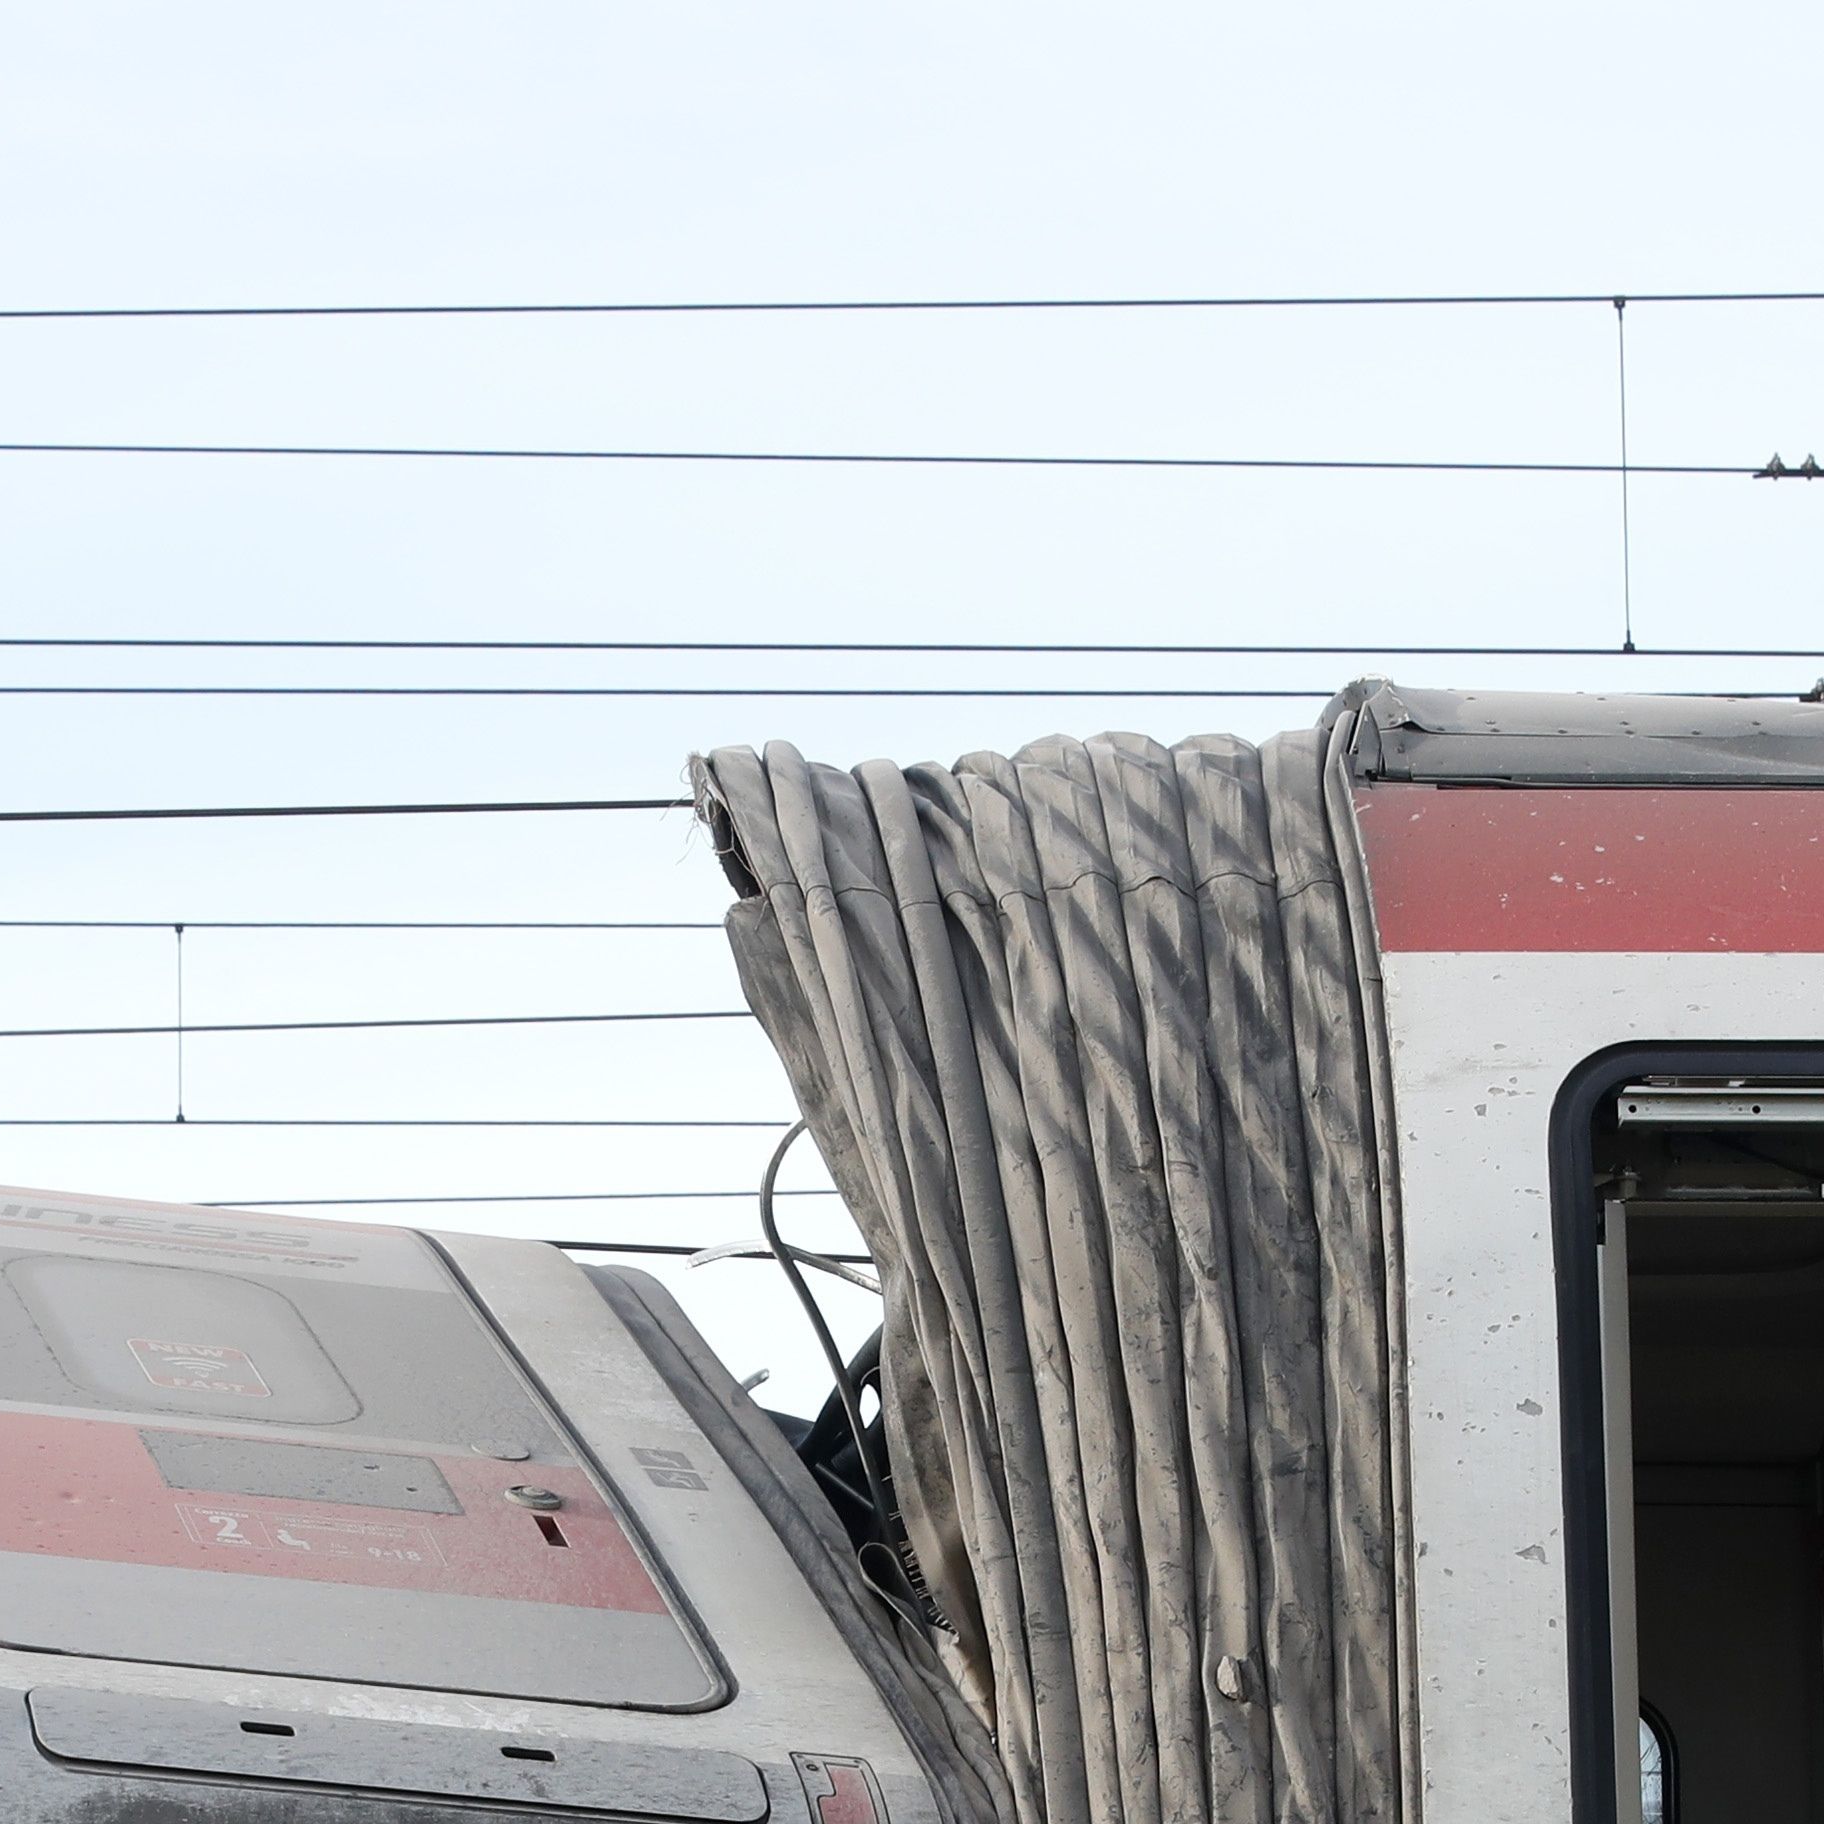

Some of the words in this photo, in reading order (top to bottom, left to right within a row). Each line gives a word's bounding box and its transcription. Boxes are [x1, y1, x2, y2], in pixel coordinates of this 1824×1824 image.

[148, 1342, 224, 1358] NEW
[173, 1378, 245, 1393] FAST
[208, 1515, 243, 1538] 2
